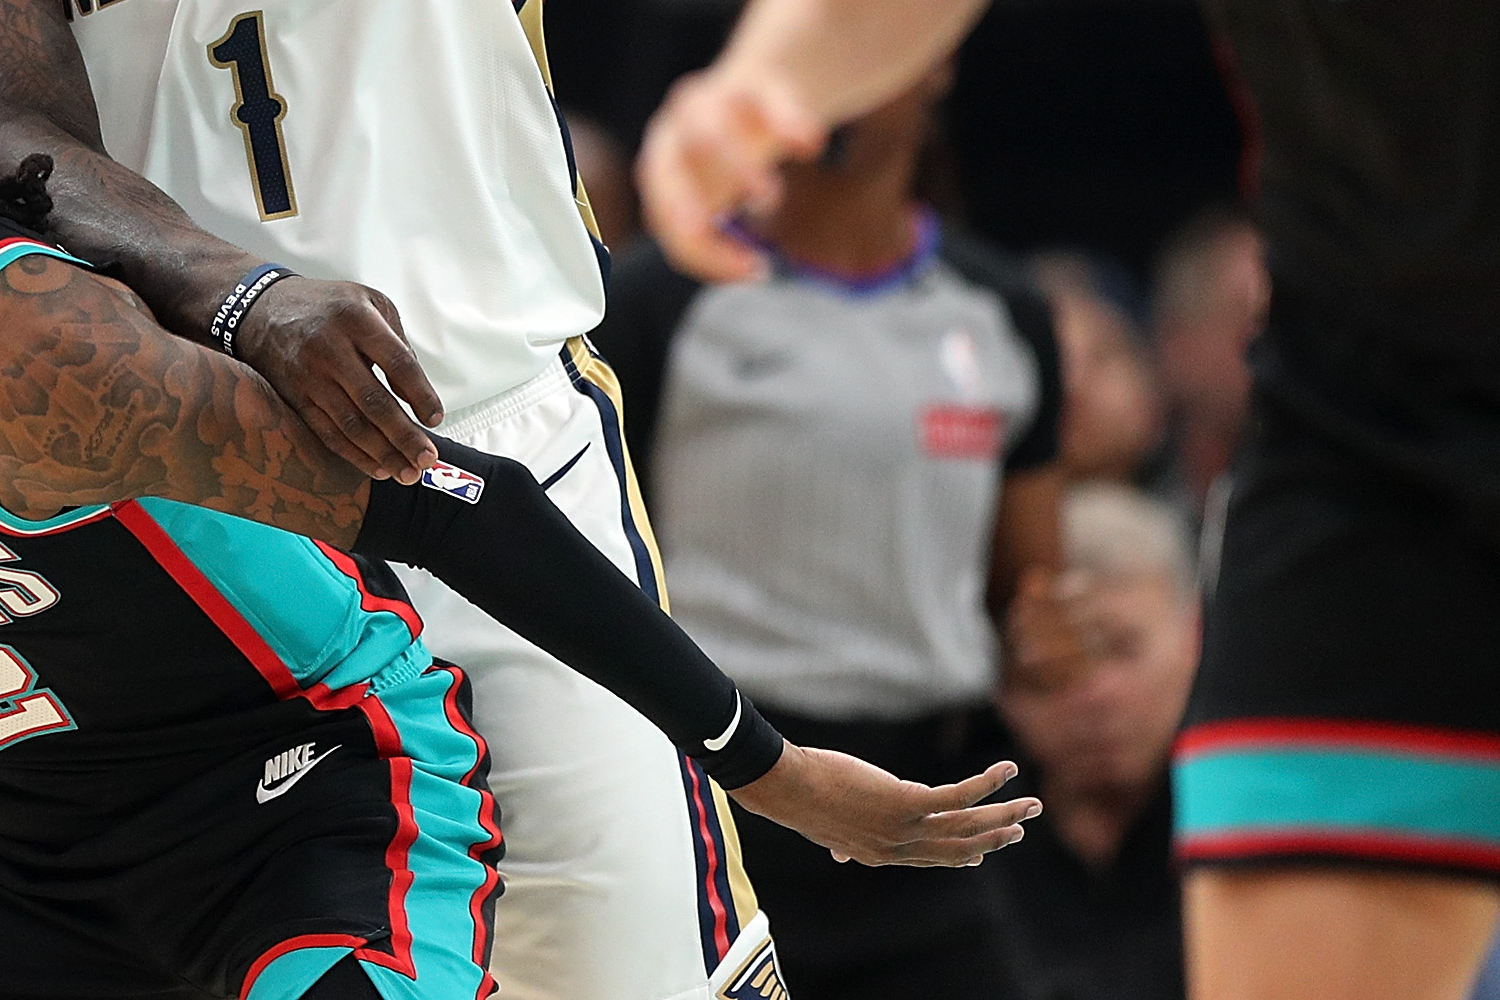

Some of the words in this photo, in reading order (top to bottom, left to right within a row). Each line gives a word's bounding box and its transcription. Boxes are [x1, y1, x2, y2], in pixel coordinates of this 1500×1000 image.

[206, 10, 298, 222] 1
[210, 283, 247, 337] D'EVILS
[240, 270, 280, 308] READY
[227, 309, 243, 329] TO
[223, 330, 233, 356] DIE
[263, 741, 317, 787] NIKE
